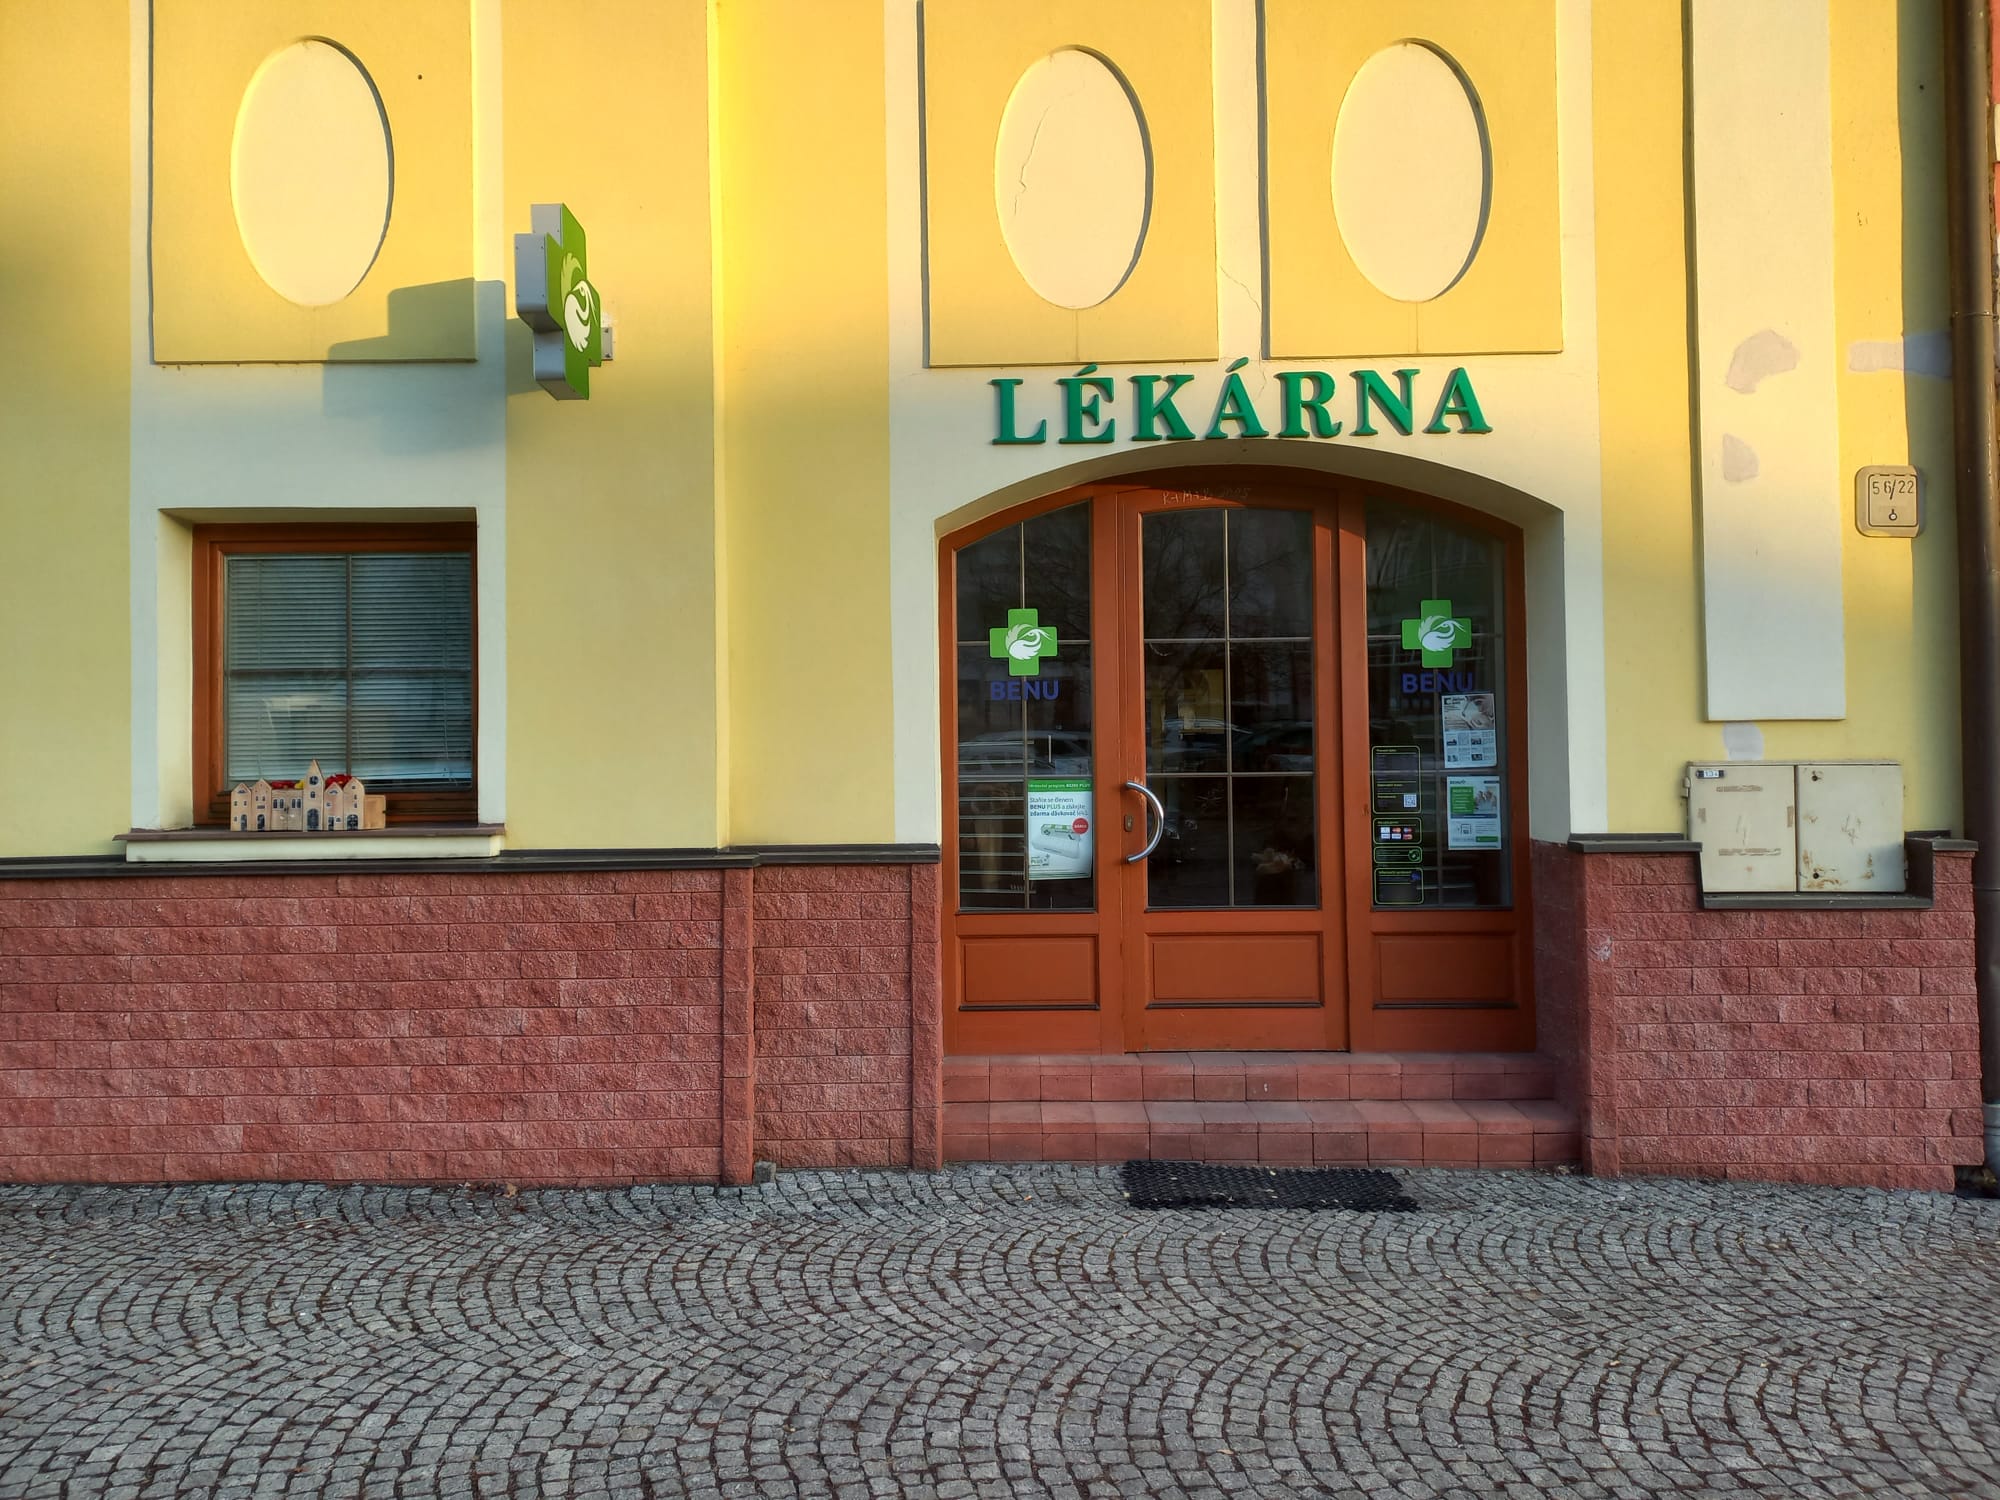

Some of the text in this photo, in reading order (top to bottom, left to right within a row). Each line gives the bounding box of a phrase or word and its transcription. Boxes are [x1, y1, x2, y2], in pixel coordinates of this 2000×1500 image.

[991, 357, 1493, 445] LÉKÁRNA
[991, 680, 1059, 700] BENU
[1402, 672, 1473, 693] BENU
